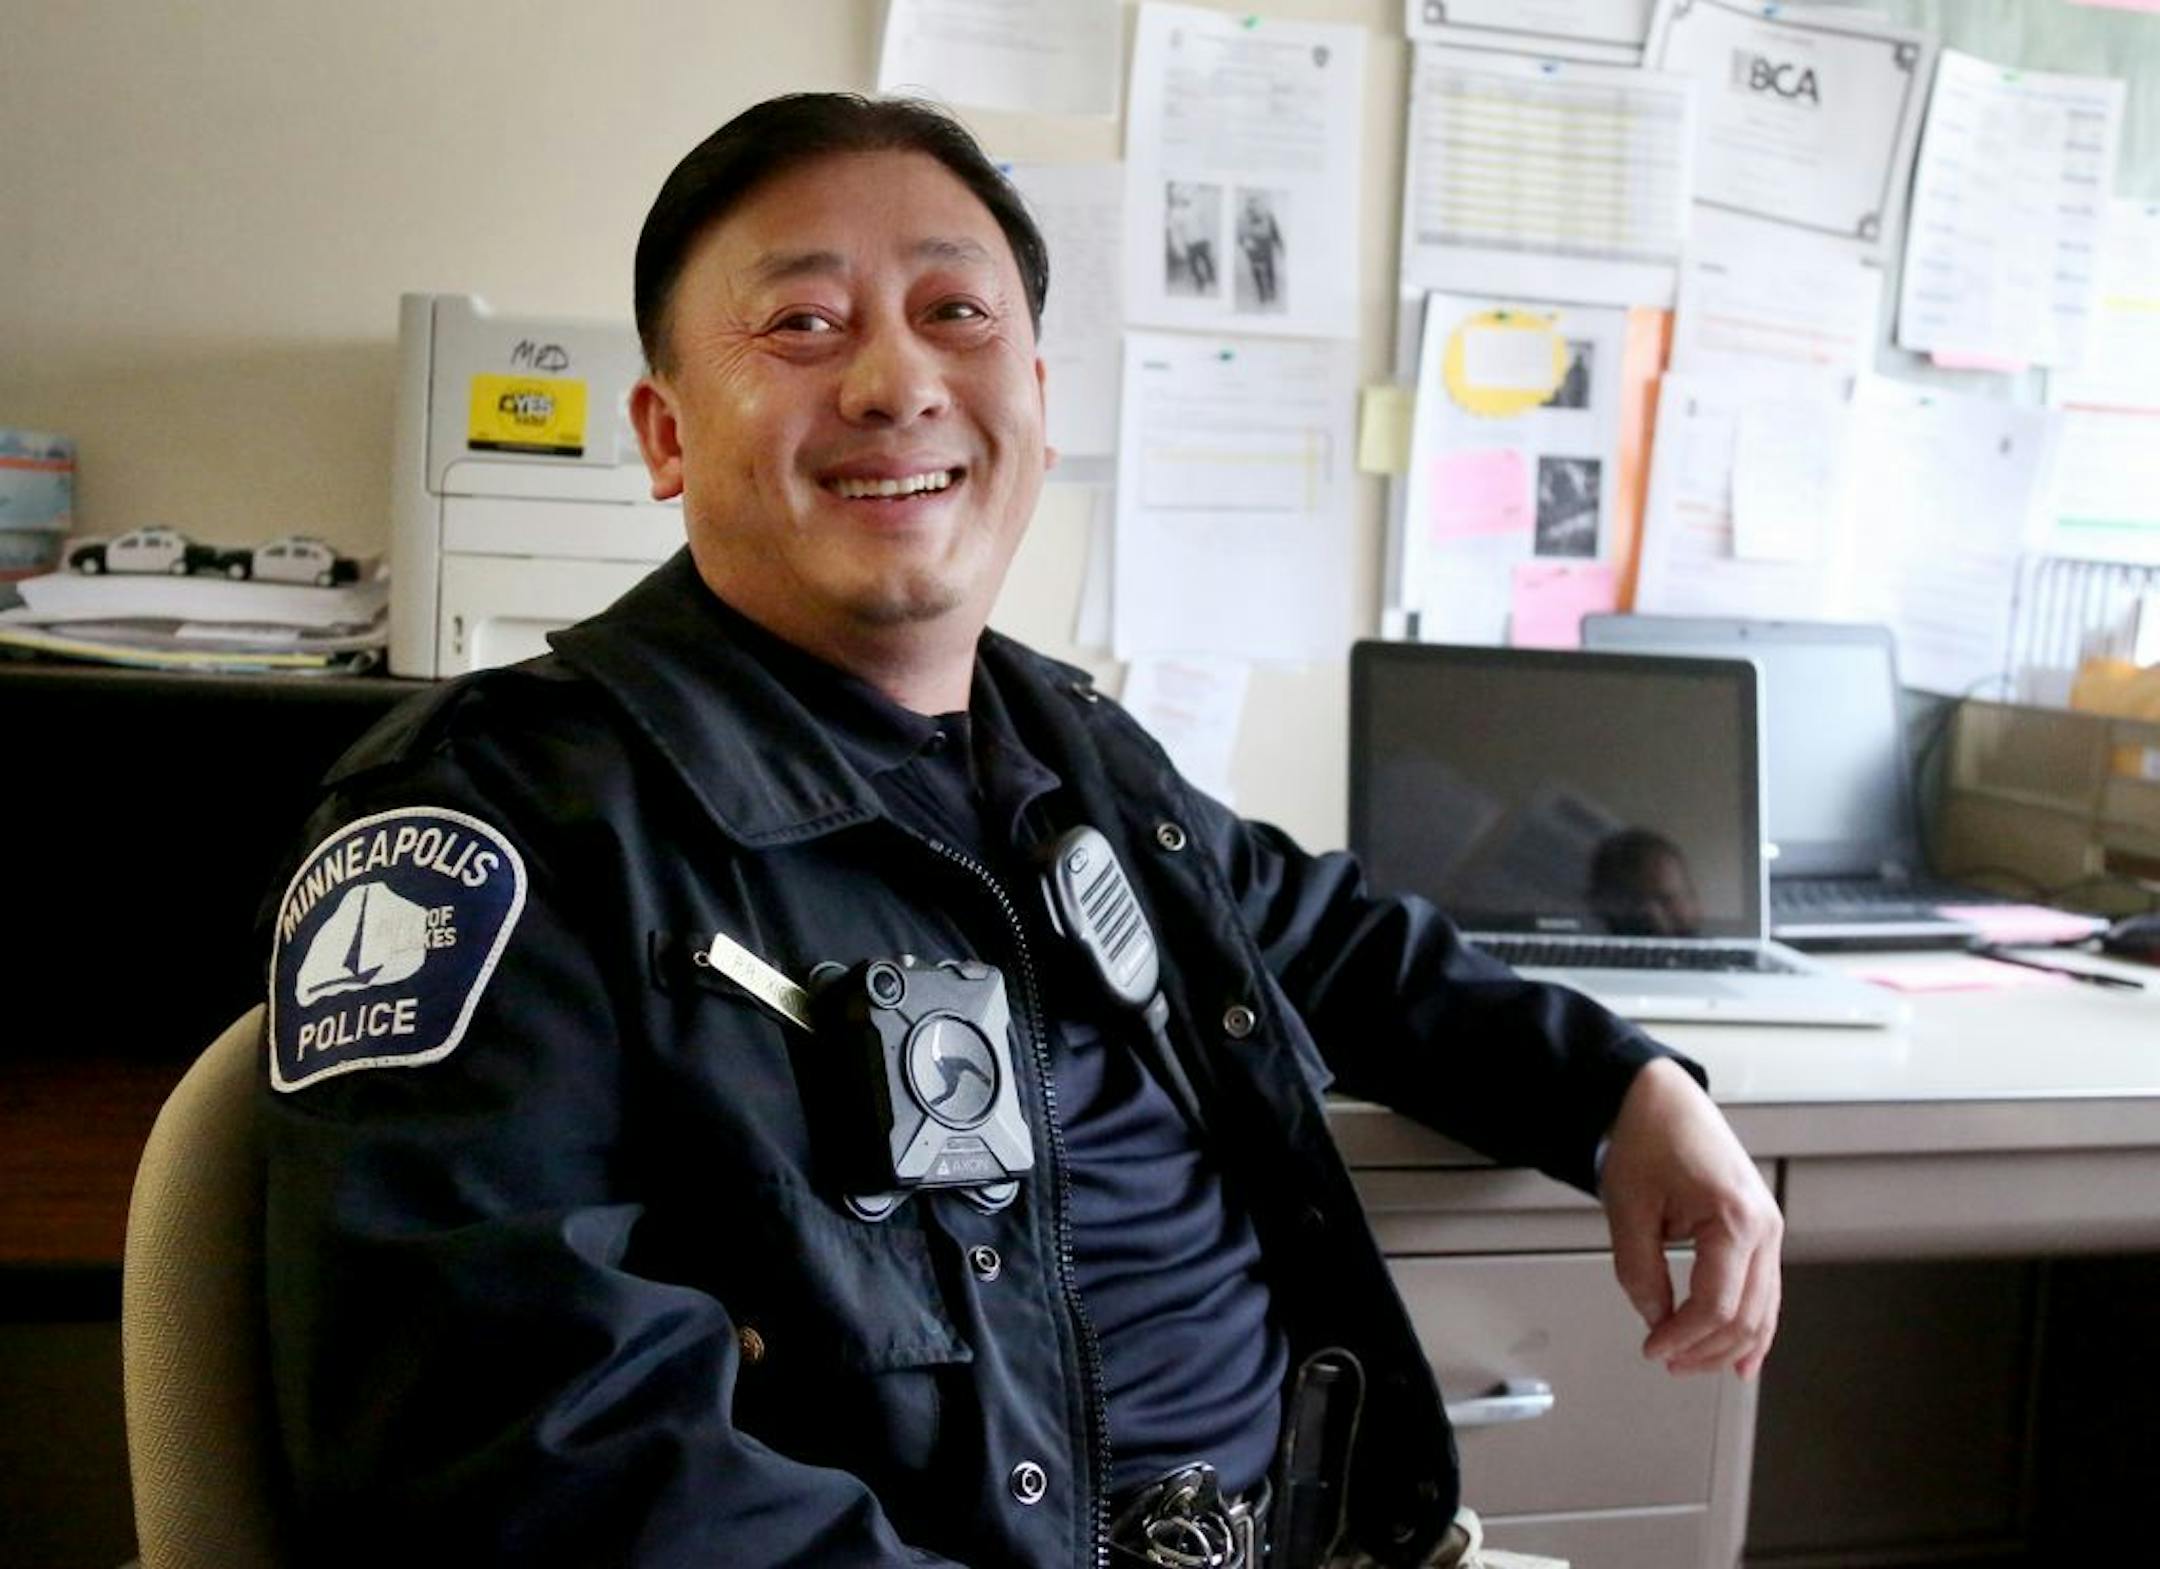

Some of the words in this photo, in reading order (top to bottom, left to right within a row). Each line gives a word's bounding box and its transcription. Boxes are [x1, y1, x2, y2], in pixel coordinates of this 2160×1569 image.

[1749, 57, 1819, 103] BCA
[283, 826, 500, 944] MINNEAPOLIS
[427, 905, 455, 928] OF
[297, 998, 419, 1062] POLICE
